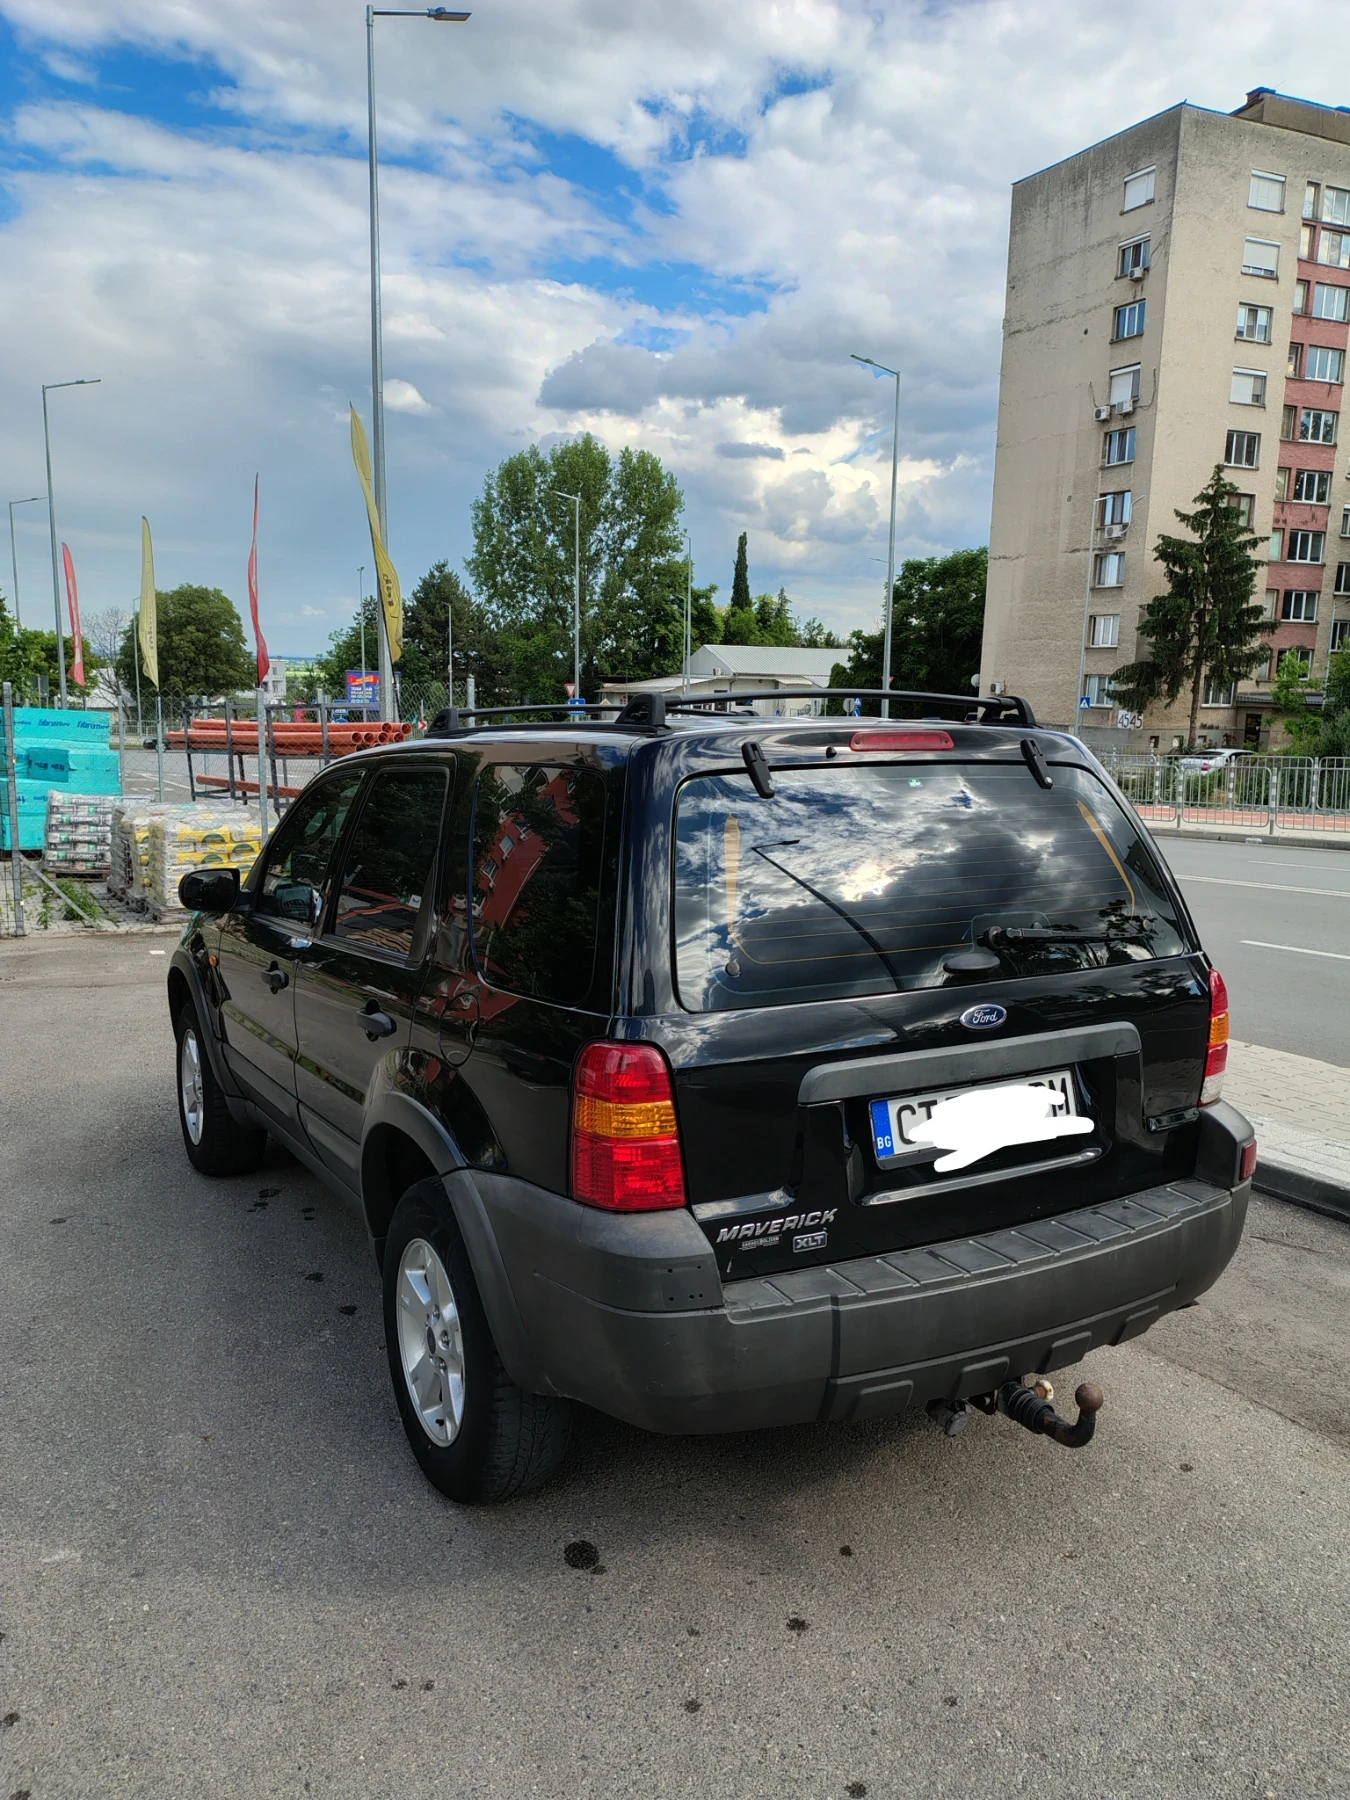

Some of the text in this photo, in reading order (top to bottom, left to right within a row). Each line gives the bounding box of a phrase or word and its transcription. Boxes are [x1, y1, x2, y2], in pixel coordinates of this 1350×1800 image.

[1118, 713, 1143, 729] 45 45
[972, 1008, 998, 1024] Ford
[876, 1135, 892, 1150] BG
[716, 1207, 838, 1244] MAVERICK
[795, 1235, 824, 1250] XLT
